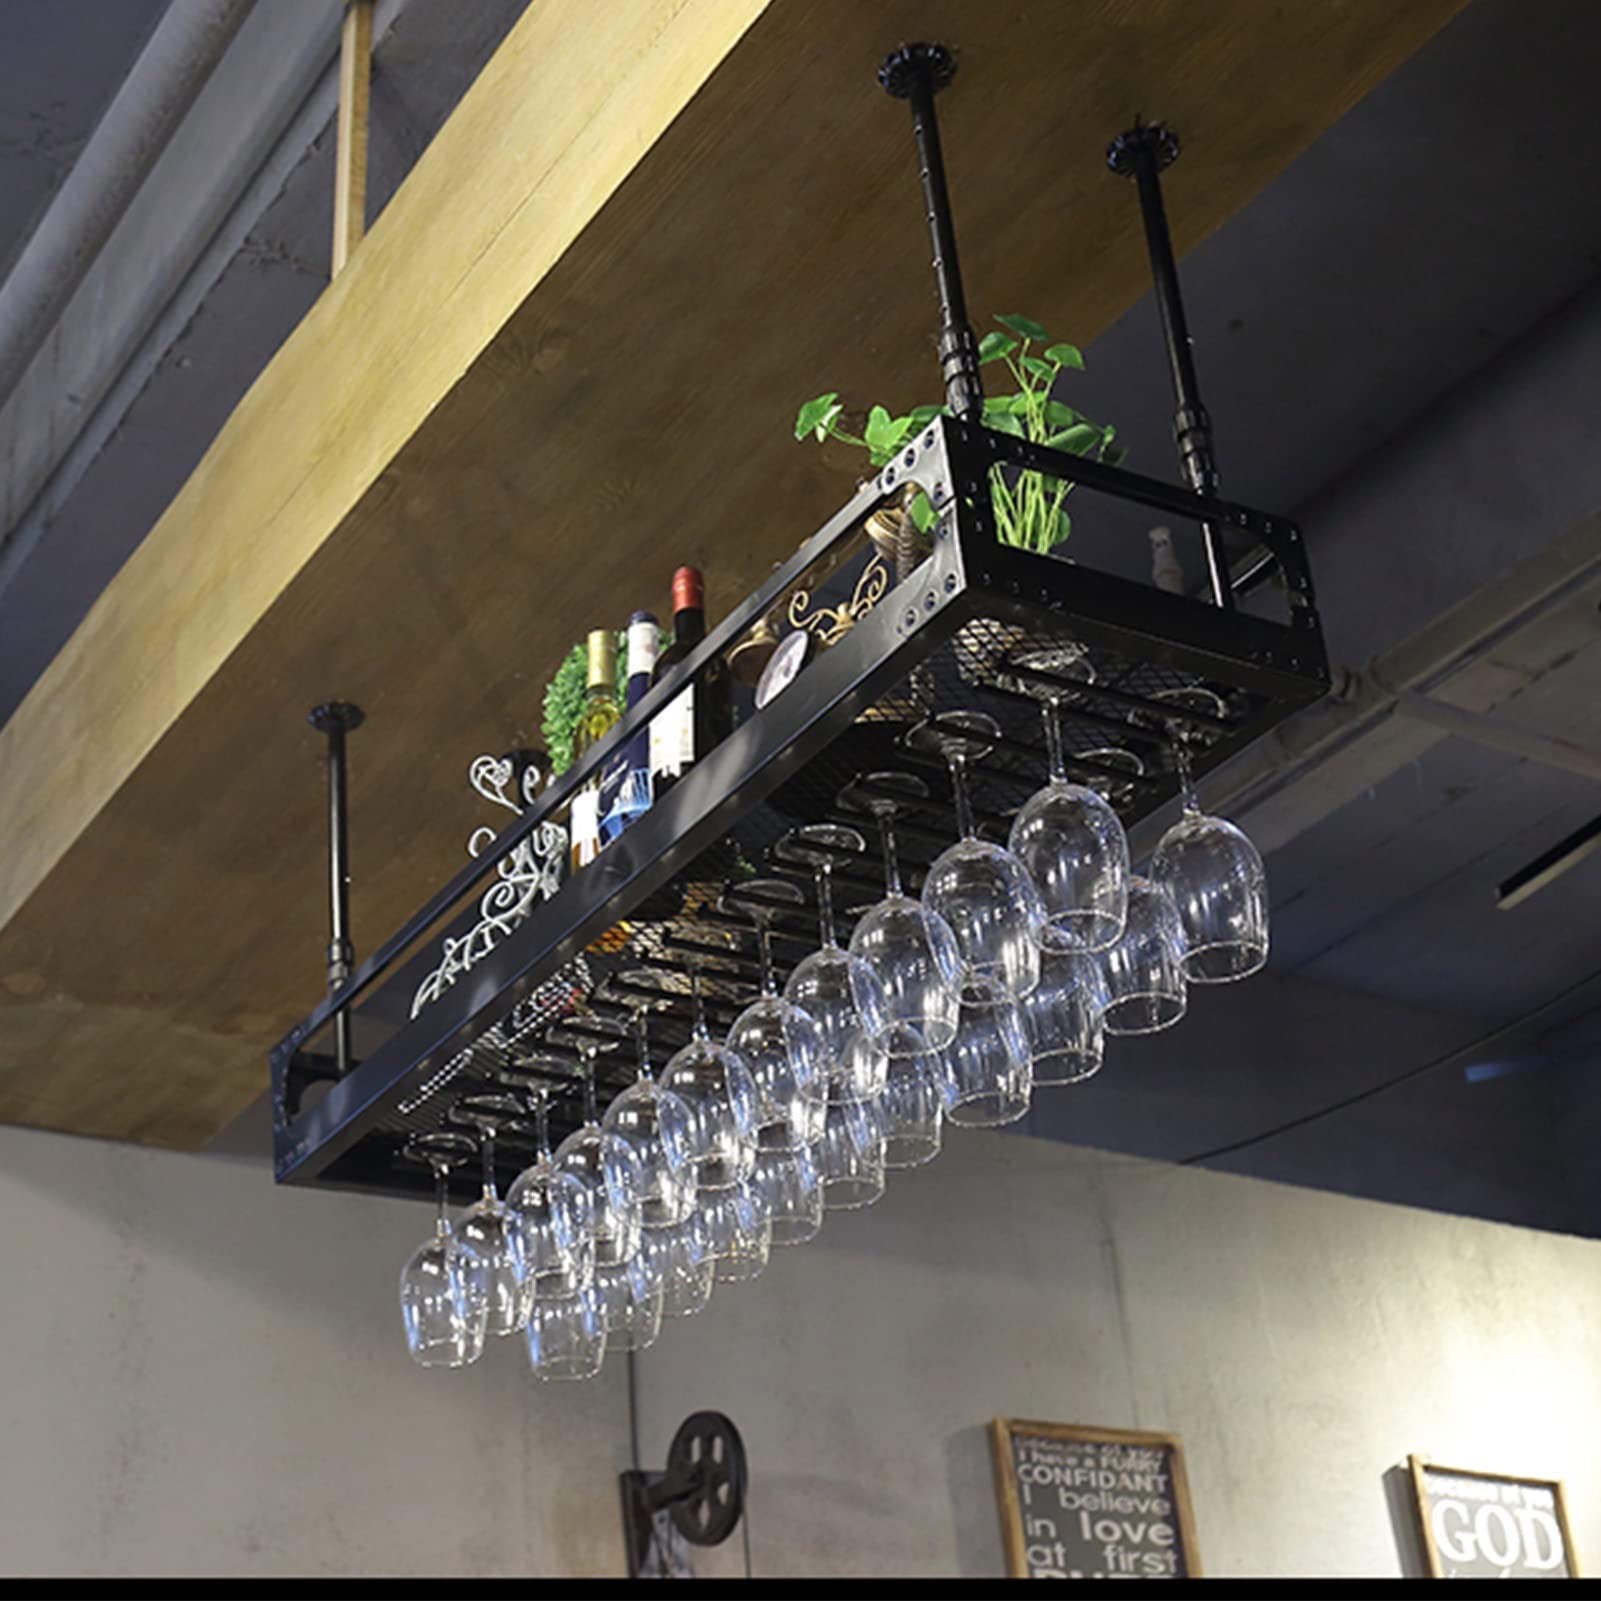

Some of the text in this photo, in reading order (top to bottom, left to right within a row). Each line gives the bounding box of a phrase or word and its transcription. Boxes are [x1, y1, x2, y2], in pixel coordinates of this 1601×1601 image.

[1018, 1464, 1168, 1492] CONFIDANT
[1059, 1487, 1171, 1515] believe
[1026, 1510, 1174, 1546] in love
[1432, 1499, 1563, 1569] GOD
[1027, 1542, 1177, 1574] at first
